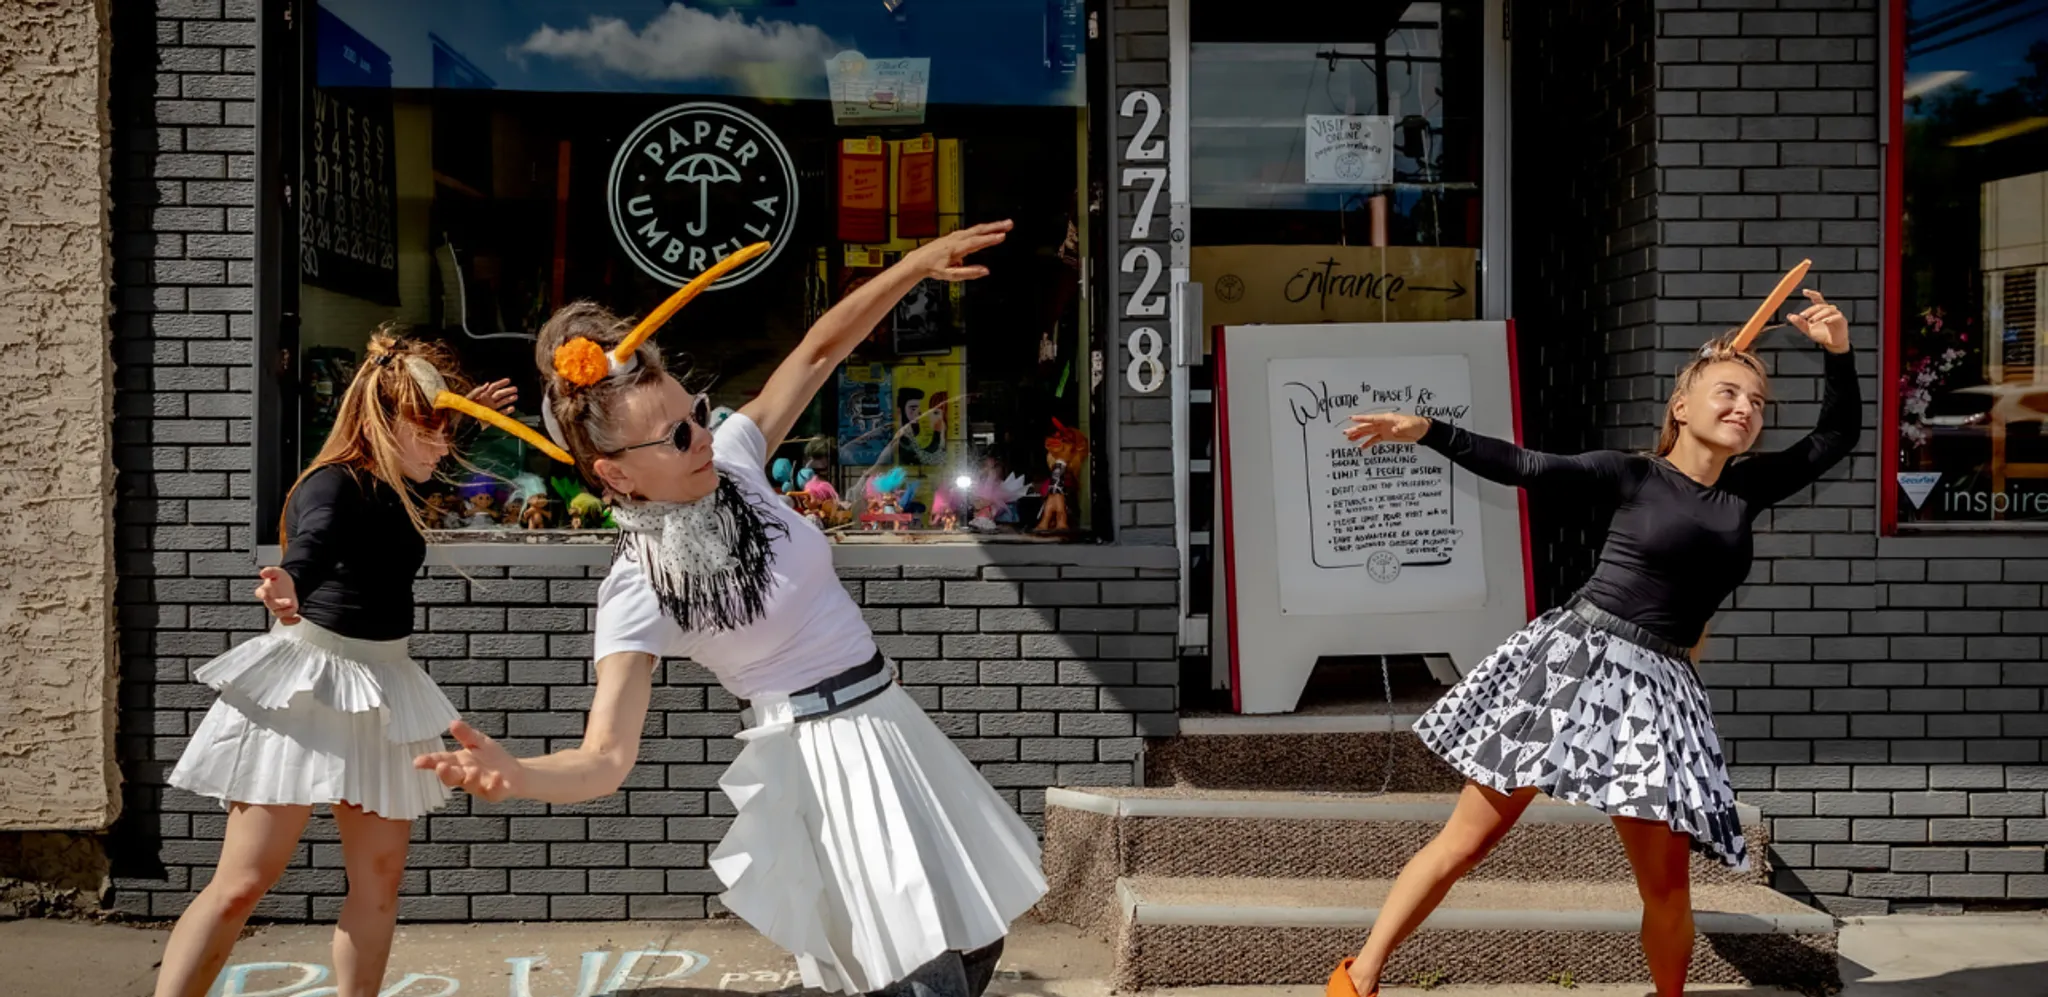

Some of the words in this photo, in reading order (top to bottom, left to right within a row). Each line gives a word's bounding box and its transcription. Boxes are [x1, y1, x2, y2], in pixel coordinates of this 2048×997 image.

[313, 87, 327, 122] W
[331, 96, 341, 130] T
[348, 106, 356, 137] F
[363, 116, 371, 146] S
[376, 125, 385, 154] S
[1311, 119, 1346, 137] VISIT
[314, 121, 324, 154] 3
[331, 131, 341, 161] 4
[349, 139, 357, 170] 5
[363, 146, 372, 176] 6
[376, 152, 385, 182] 7
[643, 120, 760, 167] PAPER
[315, 153, 328, 188] 10
[331, 162, 343, 194] 11
[350, 169, 361, 201] 12
[315, 186, 328, 218] 17
[333, 194, 346, 226] 18
[315, 218, 331, 251] 24
[334, 225, 349, 258] 25
[351, 231, 364, 263] 26
[380, 242, 394, 271] 28
[1119, 90, 1167, 394] 2728
[1284, 257, 1405, 311] Entrance
[1283, 381, 1360, 426] Welcome
[1360, 381, 1371, 393] to
[1373, 388, 1402, 404] PHASE
[1331, 446, 1363, 459] PLEASE
[1371, 443, 1416, 455] OBSERVE
[1332, 458, 1360, 468] SOCIAL
[1364, 455, 1418, 466] DISTANCING
[1332, 469, 1359, 480] LIMIT
[1376, 466, 1406, 476] PEOPLE
[1944, 482, 2048, 520] inspire
[1355, 530, 1398, 543] ADVANTAGE
